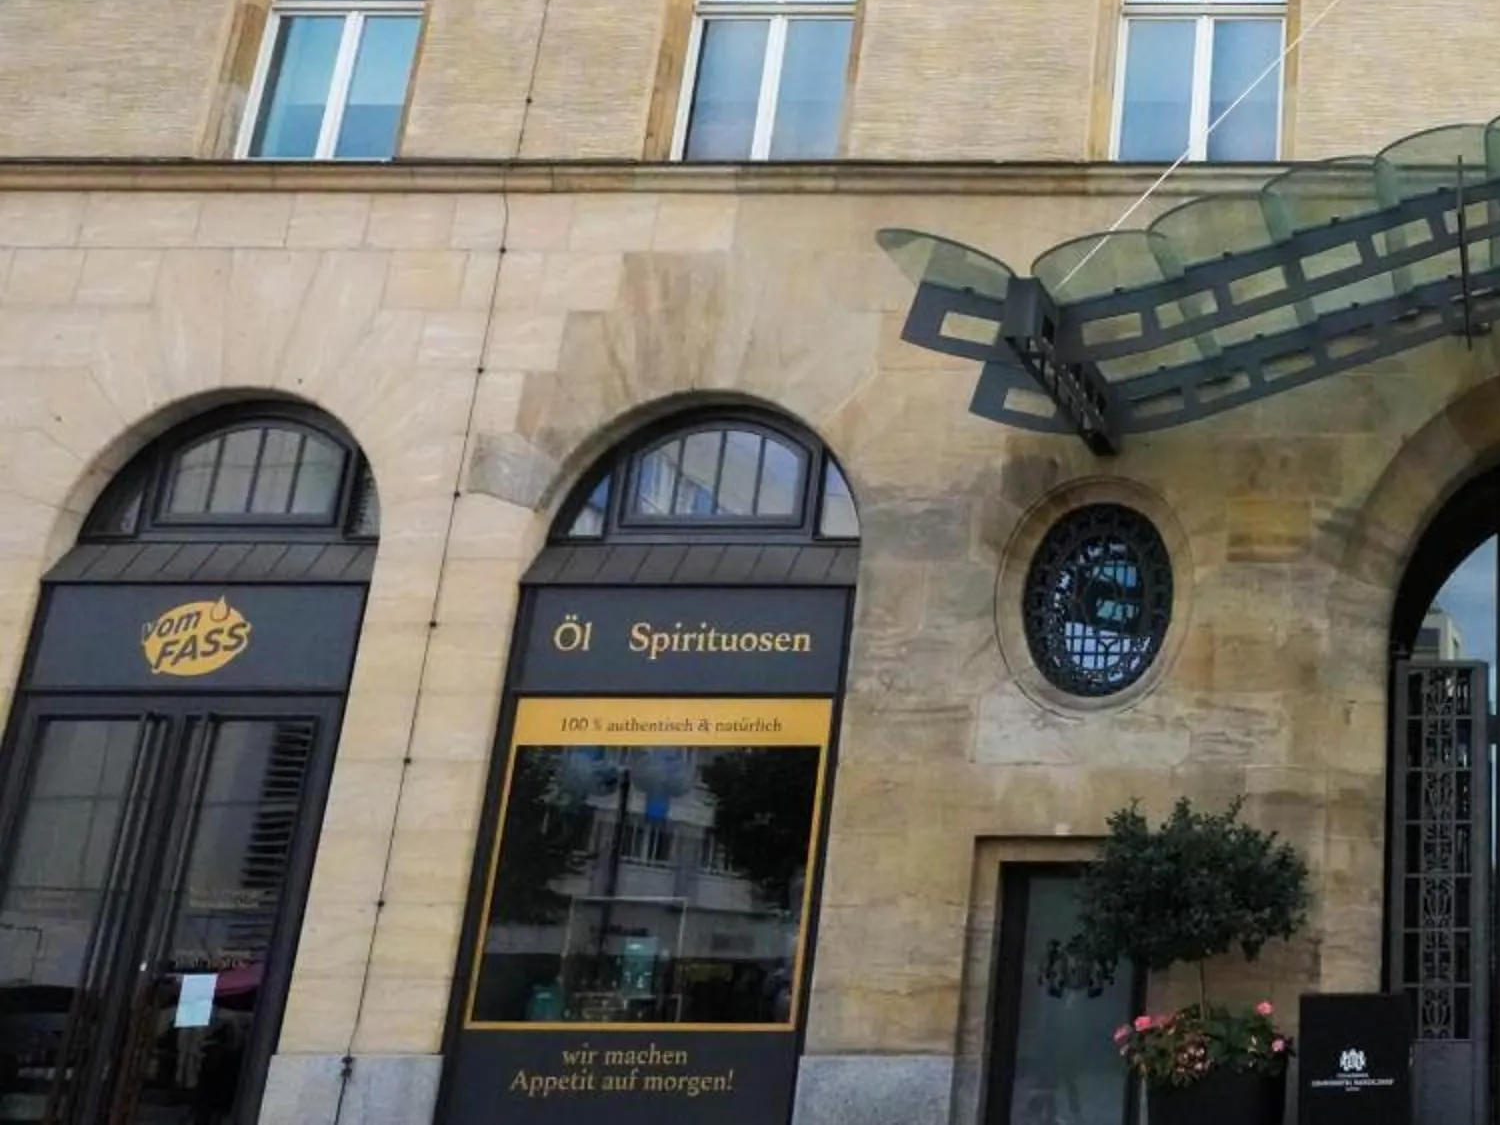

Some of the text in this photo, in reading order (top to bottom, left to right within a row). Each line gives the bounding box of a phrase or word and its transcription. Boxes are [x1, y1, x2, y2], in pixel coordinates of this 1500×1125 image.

[142, 610, 202, 643] vom
[553, 614, 812, 660] Öl Spirituosen
[153, 622, 249, 671] FASS
[560, 718, 589, 732] 100
[606, 717, 693, 732] authentisch
[714, 717, 783, 732] natürlich
[562, 1042, 688, 1065] wir machen
[509, 1068, 734, 1097] Appetit auf morgen!
